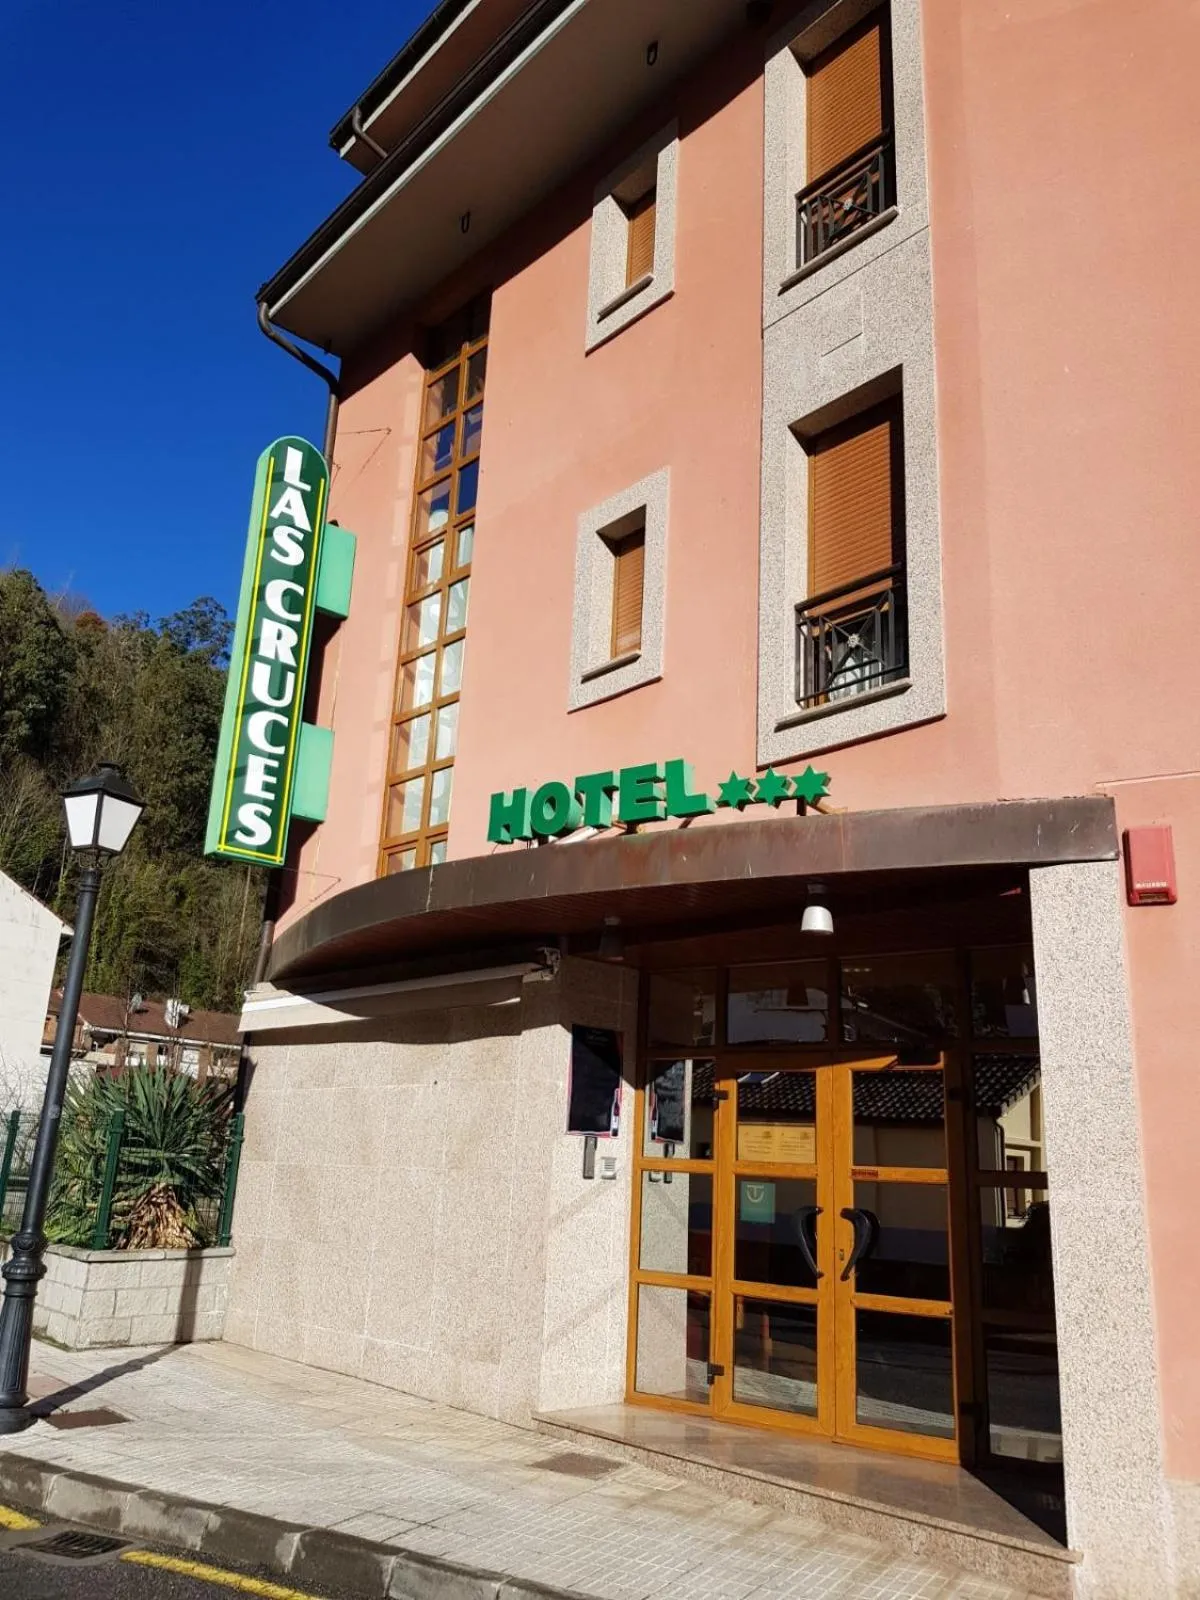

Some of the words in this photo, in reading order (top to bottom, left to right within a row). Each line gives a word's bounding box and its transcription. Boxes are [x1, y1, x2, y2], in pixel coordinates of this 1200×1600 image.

[270, 446, 312, 567] LAS
[235, 579, 305, 847] CRUCES
[487, 759, 715, 844] HOTEL
